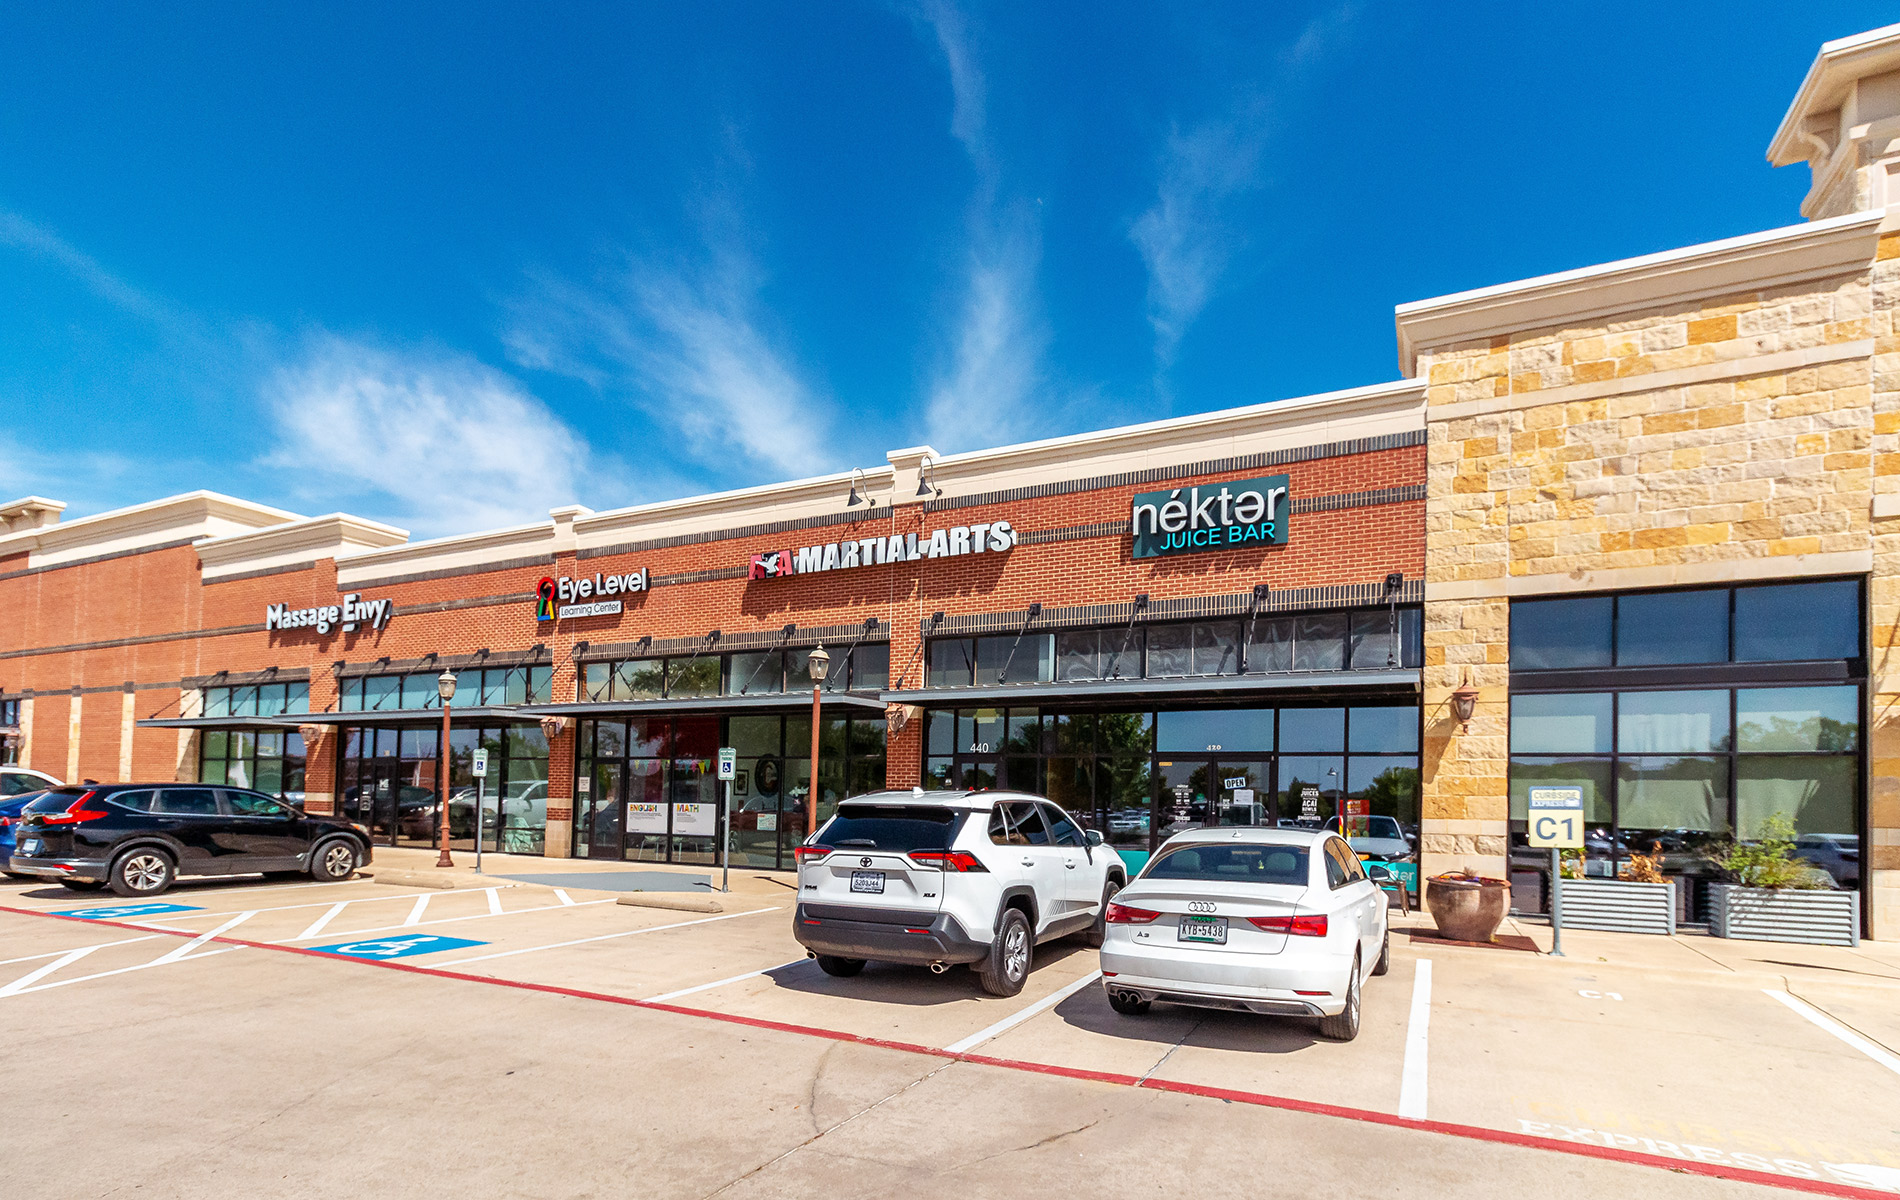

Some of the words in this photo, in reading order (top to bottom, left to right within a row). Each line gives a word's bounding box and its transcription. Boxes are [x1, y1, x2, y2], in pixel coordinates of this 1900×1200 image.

[1160, 527, 1221, 550] JUICE
[1228, 522, 1275, 543] BAR
[799, 533, 921, 574] MARTIAL
[928, 521, 1012, 558] ARTS
[559, 576, 592, 604] Eye
[596, 567, 647, 595] Level
[561, 605, 592, 616] Learning
[593, 603, 620, 613] Center
[266, 602, 342, 635] Massage
[970, 742, 989, 753] 440
[1226, 779, 1244, 788] OPEN
[1533, 791, 1577, 799] CURBSIDE
[629, 804, 658, 812] ENGLISH
[676, 803, 700, 813] MATH
[1536, 817, 1573, 840] C1
[1136, 930, 1150, 938] A3
[1577, 989, 1624, 1000] C1
[1516, 1118, 1821, 1179] EXPRESS
